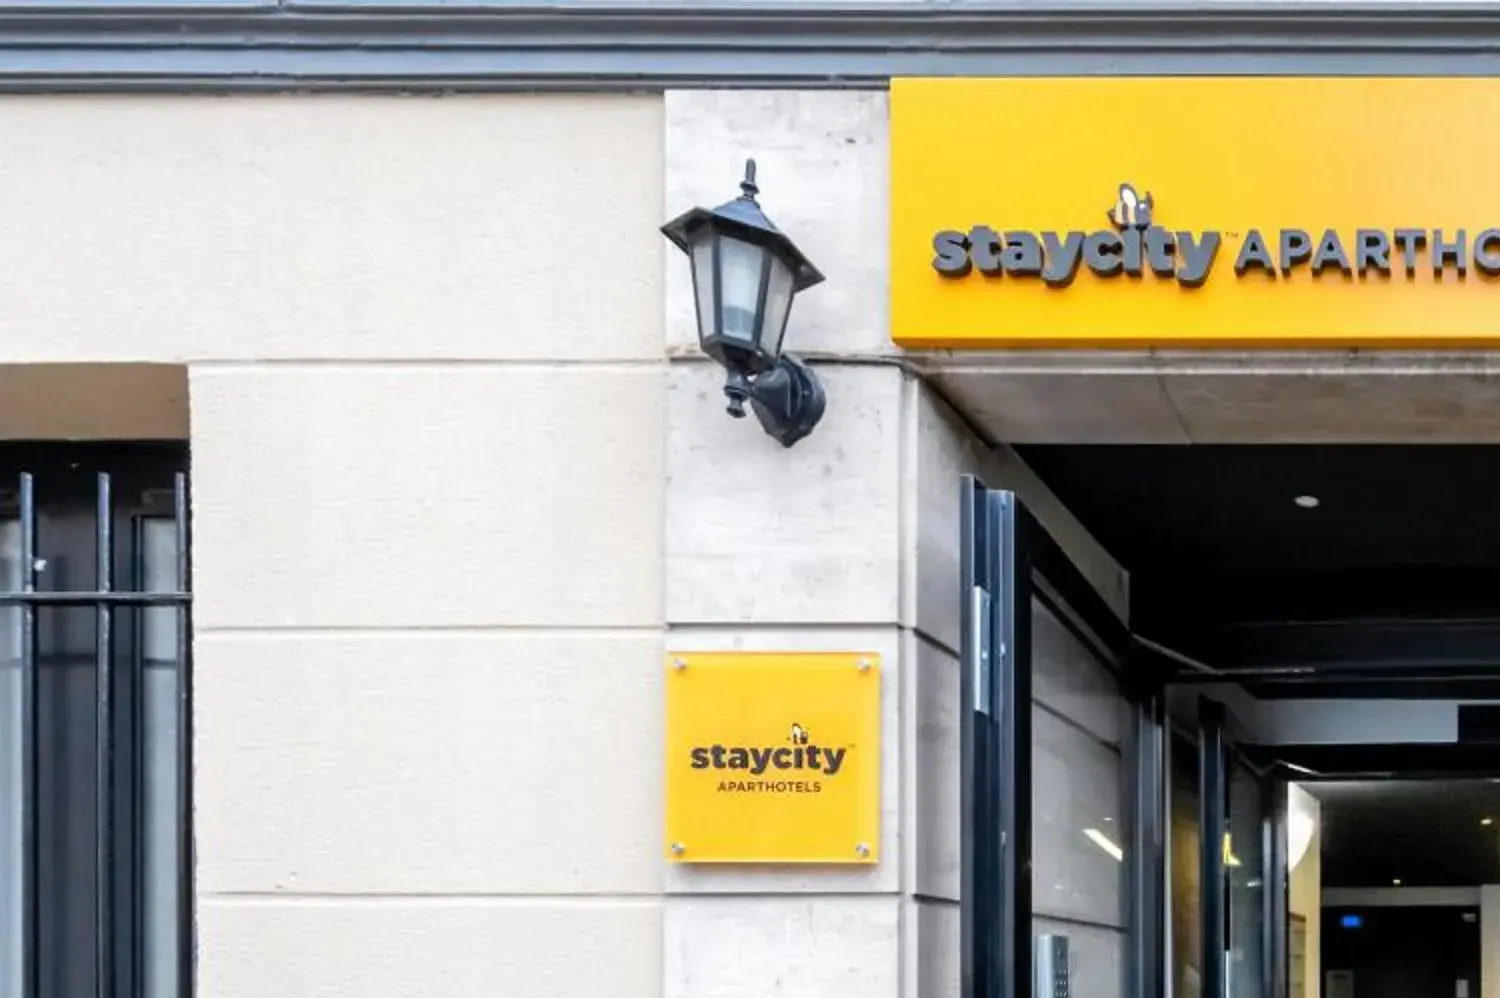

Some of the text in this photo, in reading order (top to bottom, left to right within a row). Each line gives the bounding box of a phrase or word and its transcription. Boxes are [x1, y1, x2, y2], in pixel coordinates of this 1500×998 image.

[932, 218, 1221, 288] staycity
[691, 743, 847, 775] staycity
[717, 781, 822, 793] APARTHOTELS
